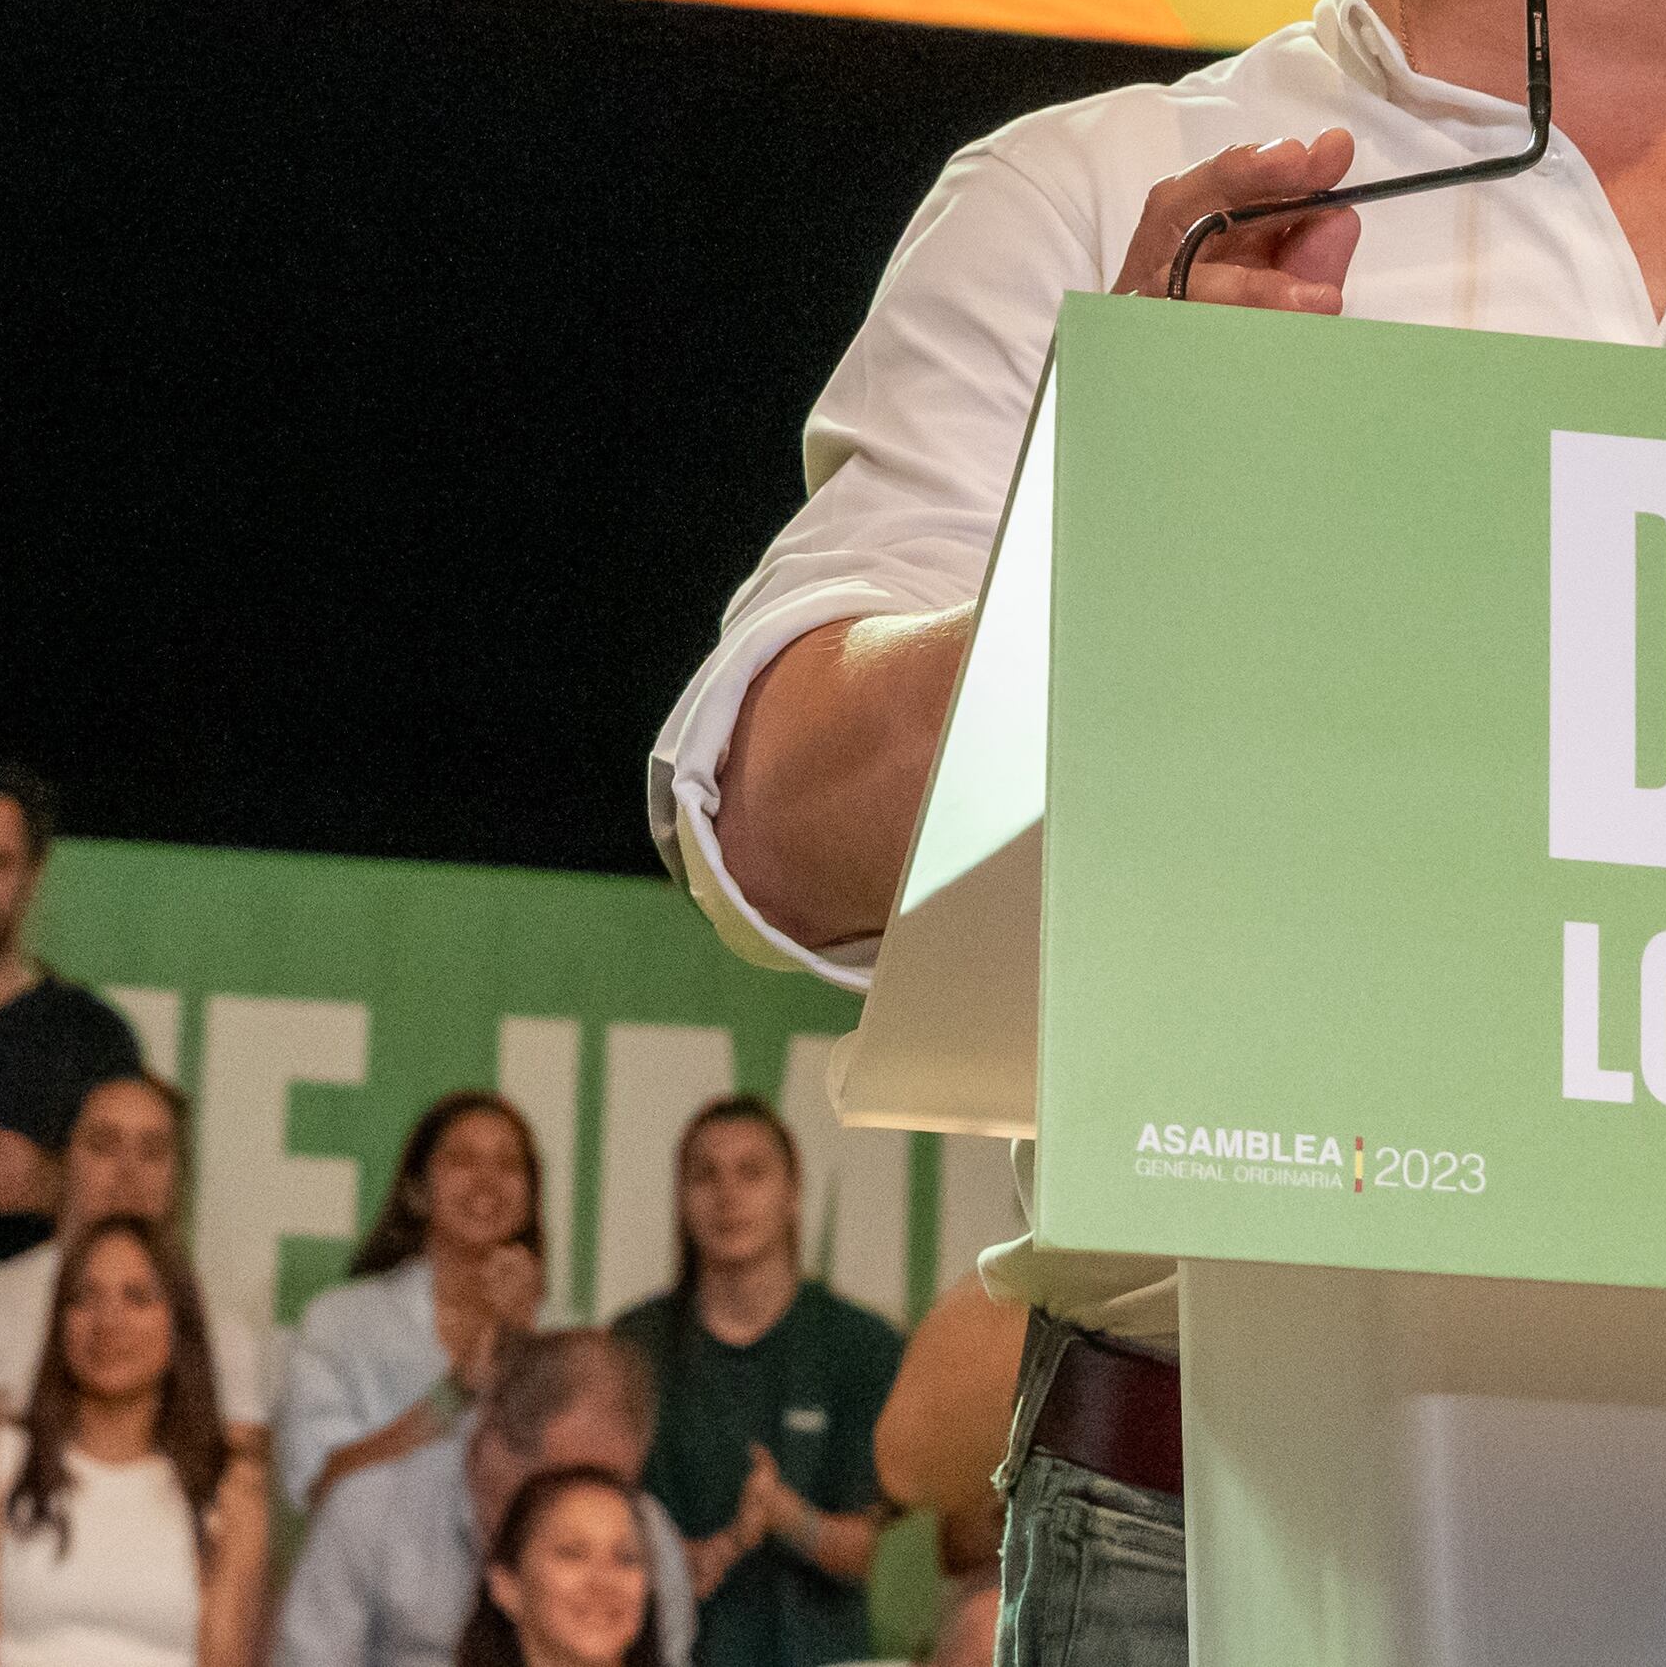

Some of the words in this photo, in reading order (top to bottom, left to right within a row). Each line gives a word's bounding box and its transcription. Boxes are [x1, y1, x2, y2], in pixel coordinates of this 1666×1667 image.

[1136, 1123, 1343, 1166] ASAMBLEA
[1134, 1157, 1226, 1182] GENERAL
[1233, 1164, 1344, 1190] ORDINARIA
[1374, 1146, 1487, 1193] 2023
